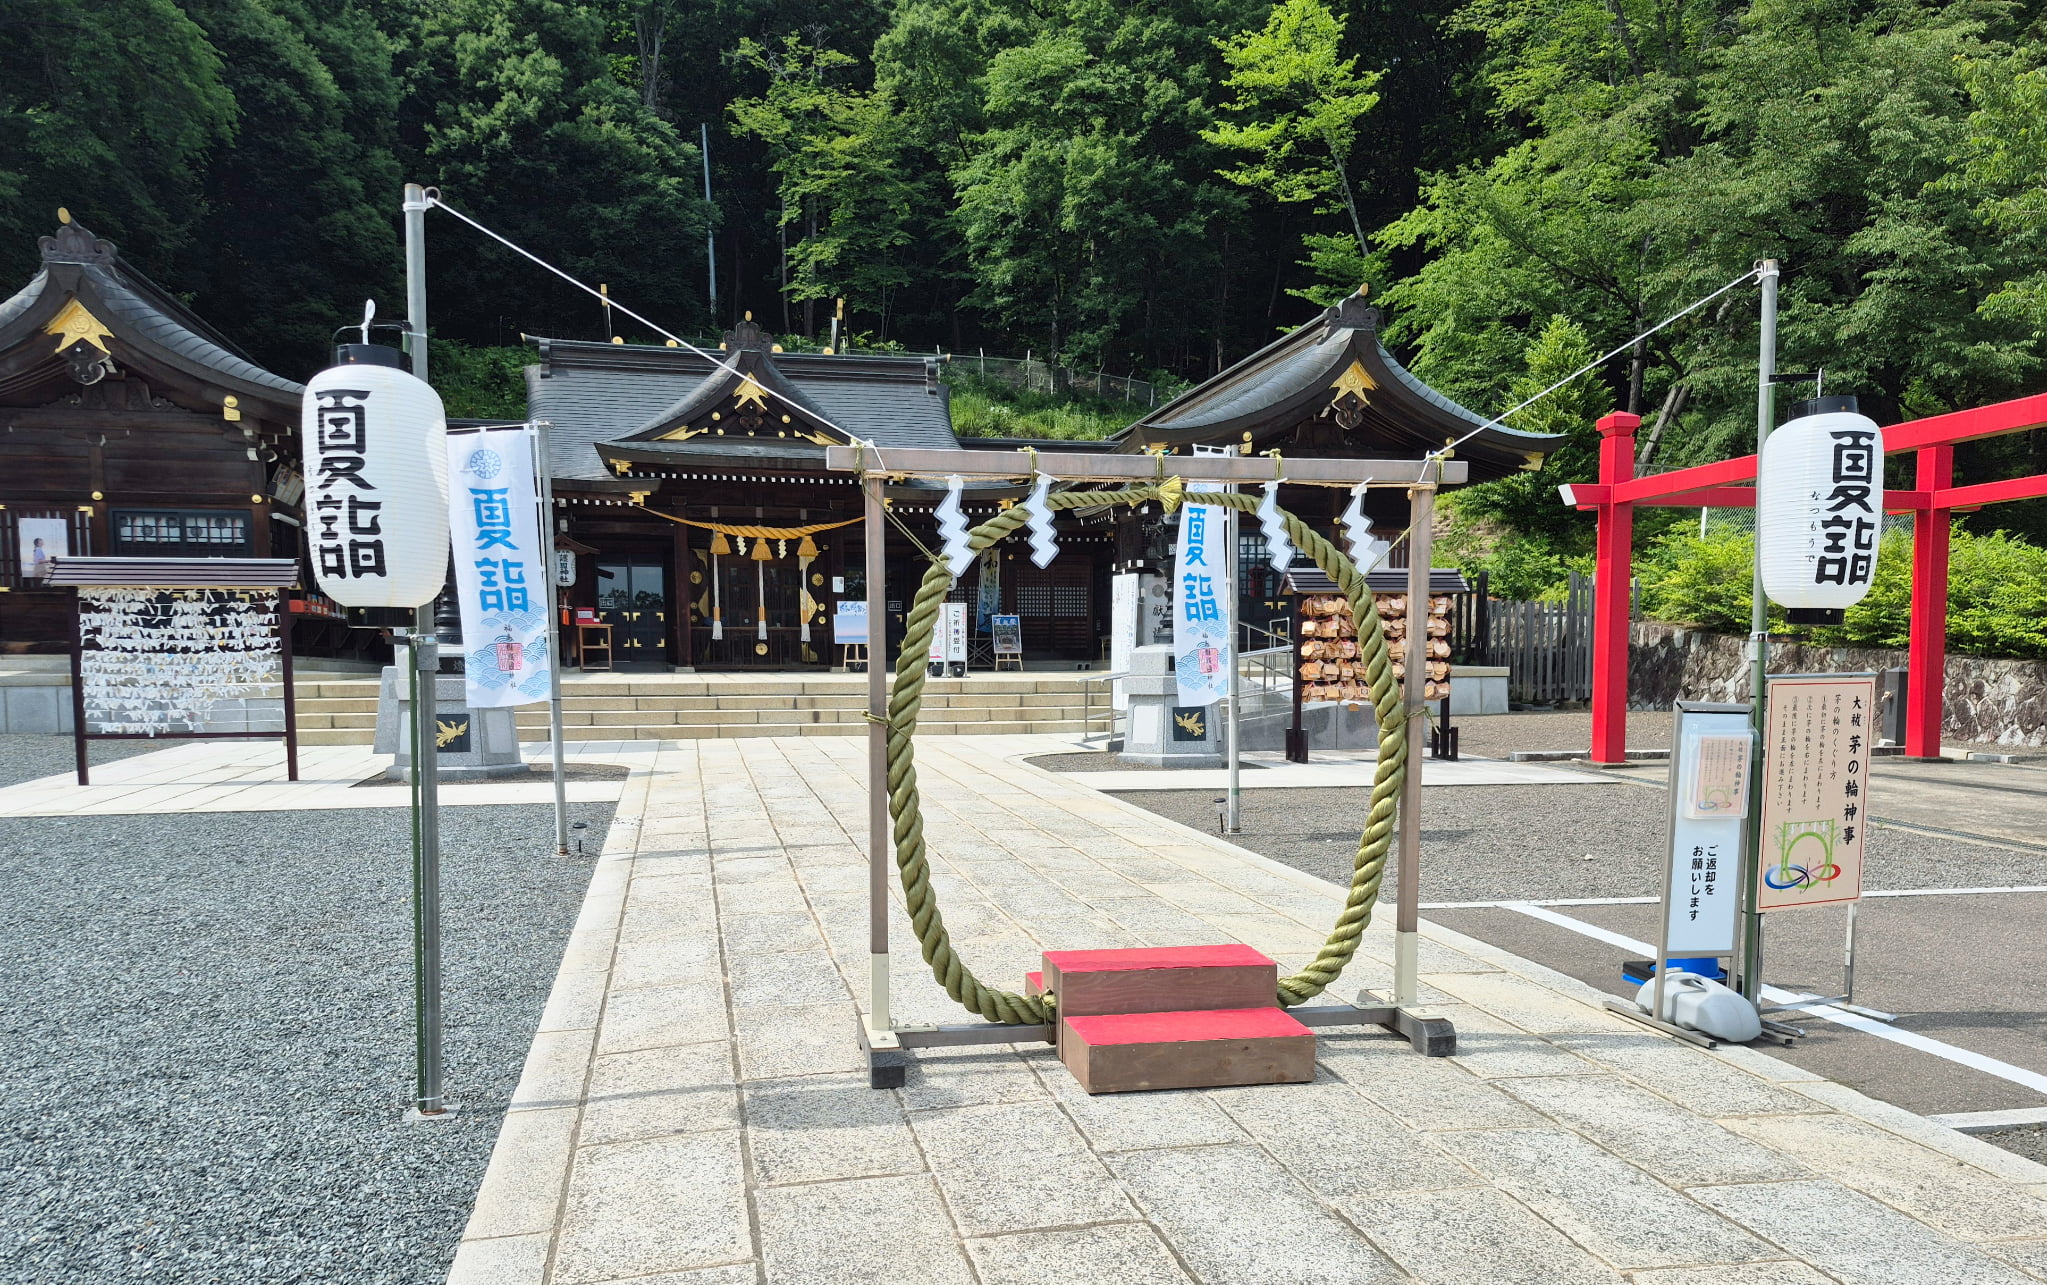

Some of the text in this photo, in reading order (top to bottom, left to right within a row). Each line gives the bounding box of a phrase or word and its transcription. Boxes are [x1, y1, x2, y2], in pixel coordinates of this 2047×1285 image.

[315, 389, 387, 579] 夏詣
[1804, 490, 1821, 564] なつもうで
[1815, 430, 1876, 586] 夏詣
[468, 487, 529, 613] 夏詣
[1183, 507, 1219, 622] 夏詣
[1688, 845, 1704, 922] お願いします
[1704, 844, 1719, 896] ご返却を
